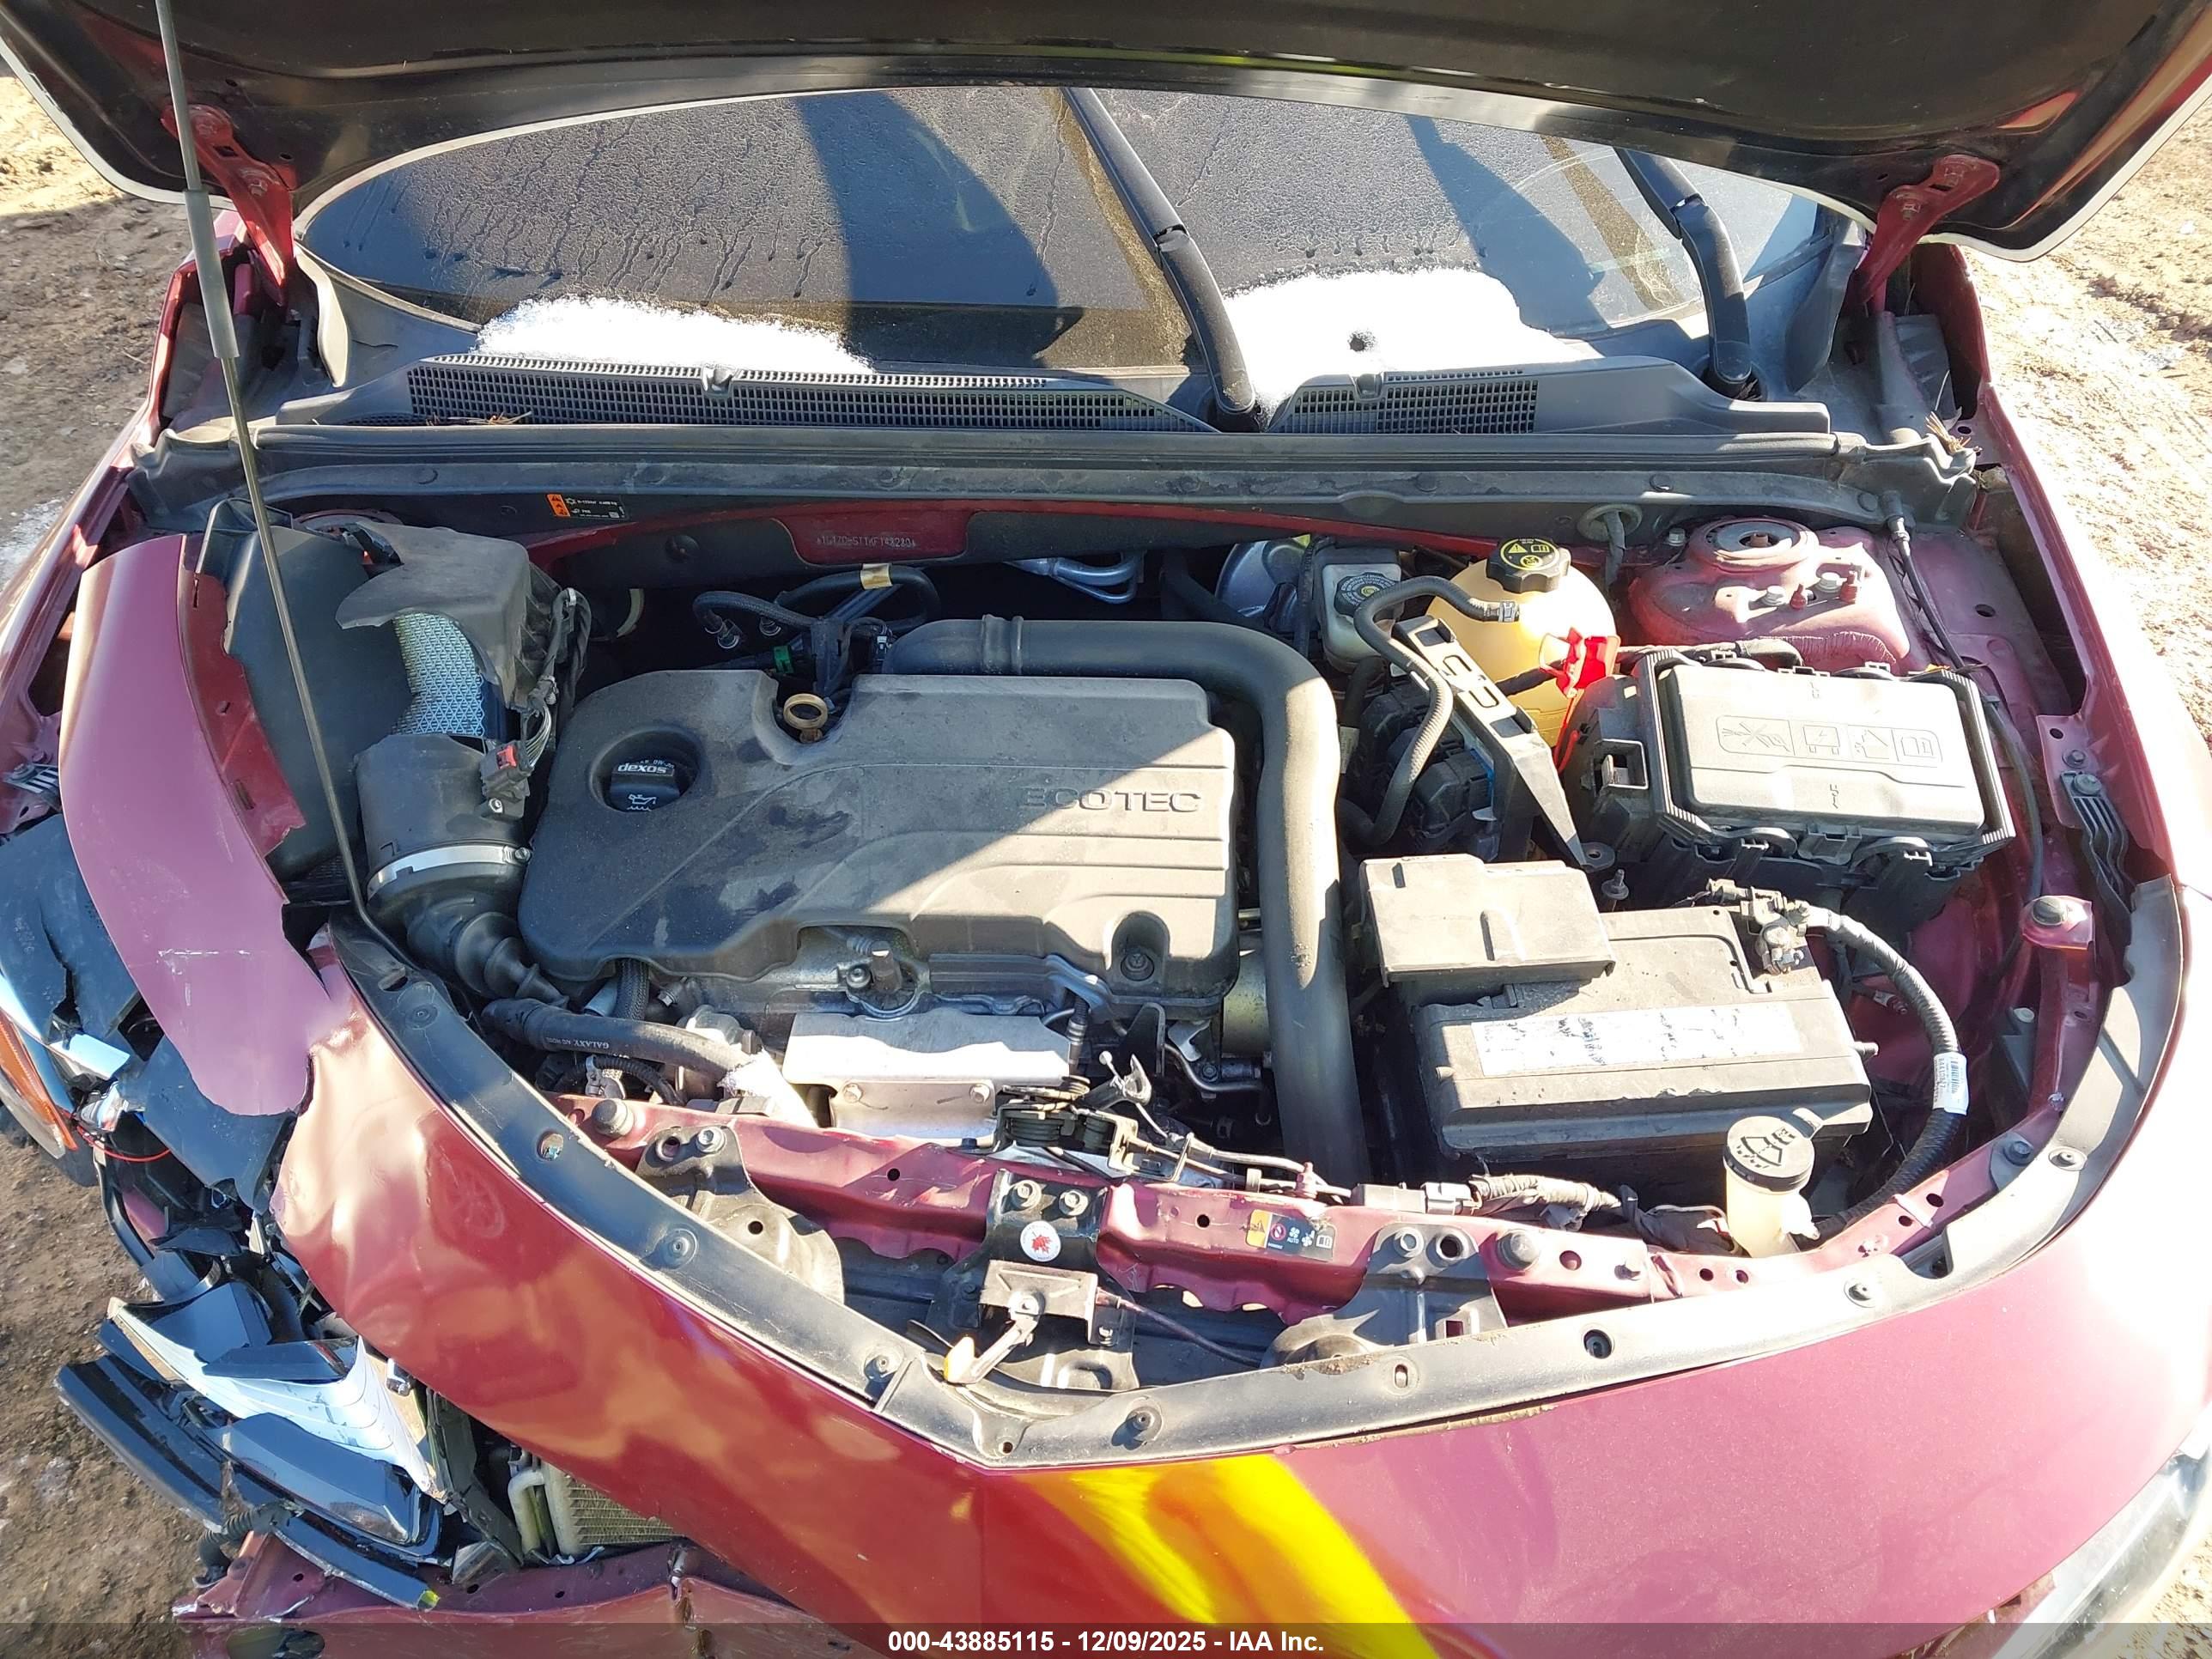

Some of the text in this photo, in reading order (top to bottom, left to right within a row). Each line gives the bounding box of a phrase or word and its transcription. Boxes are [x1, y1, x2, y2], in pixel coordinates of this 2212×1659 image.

[617, 763, 667, 774] dexos
[1019, 786, 1201, 813] ECOTEC
[573, 1039, 610, 1049] GALAXY
